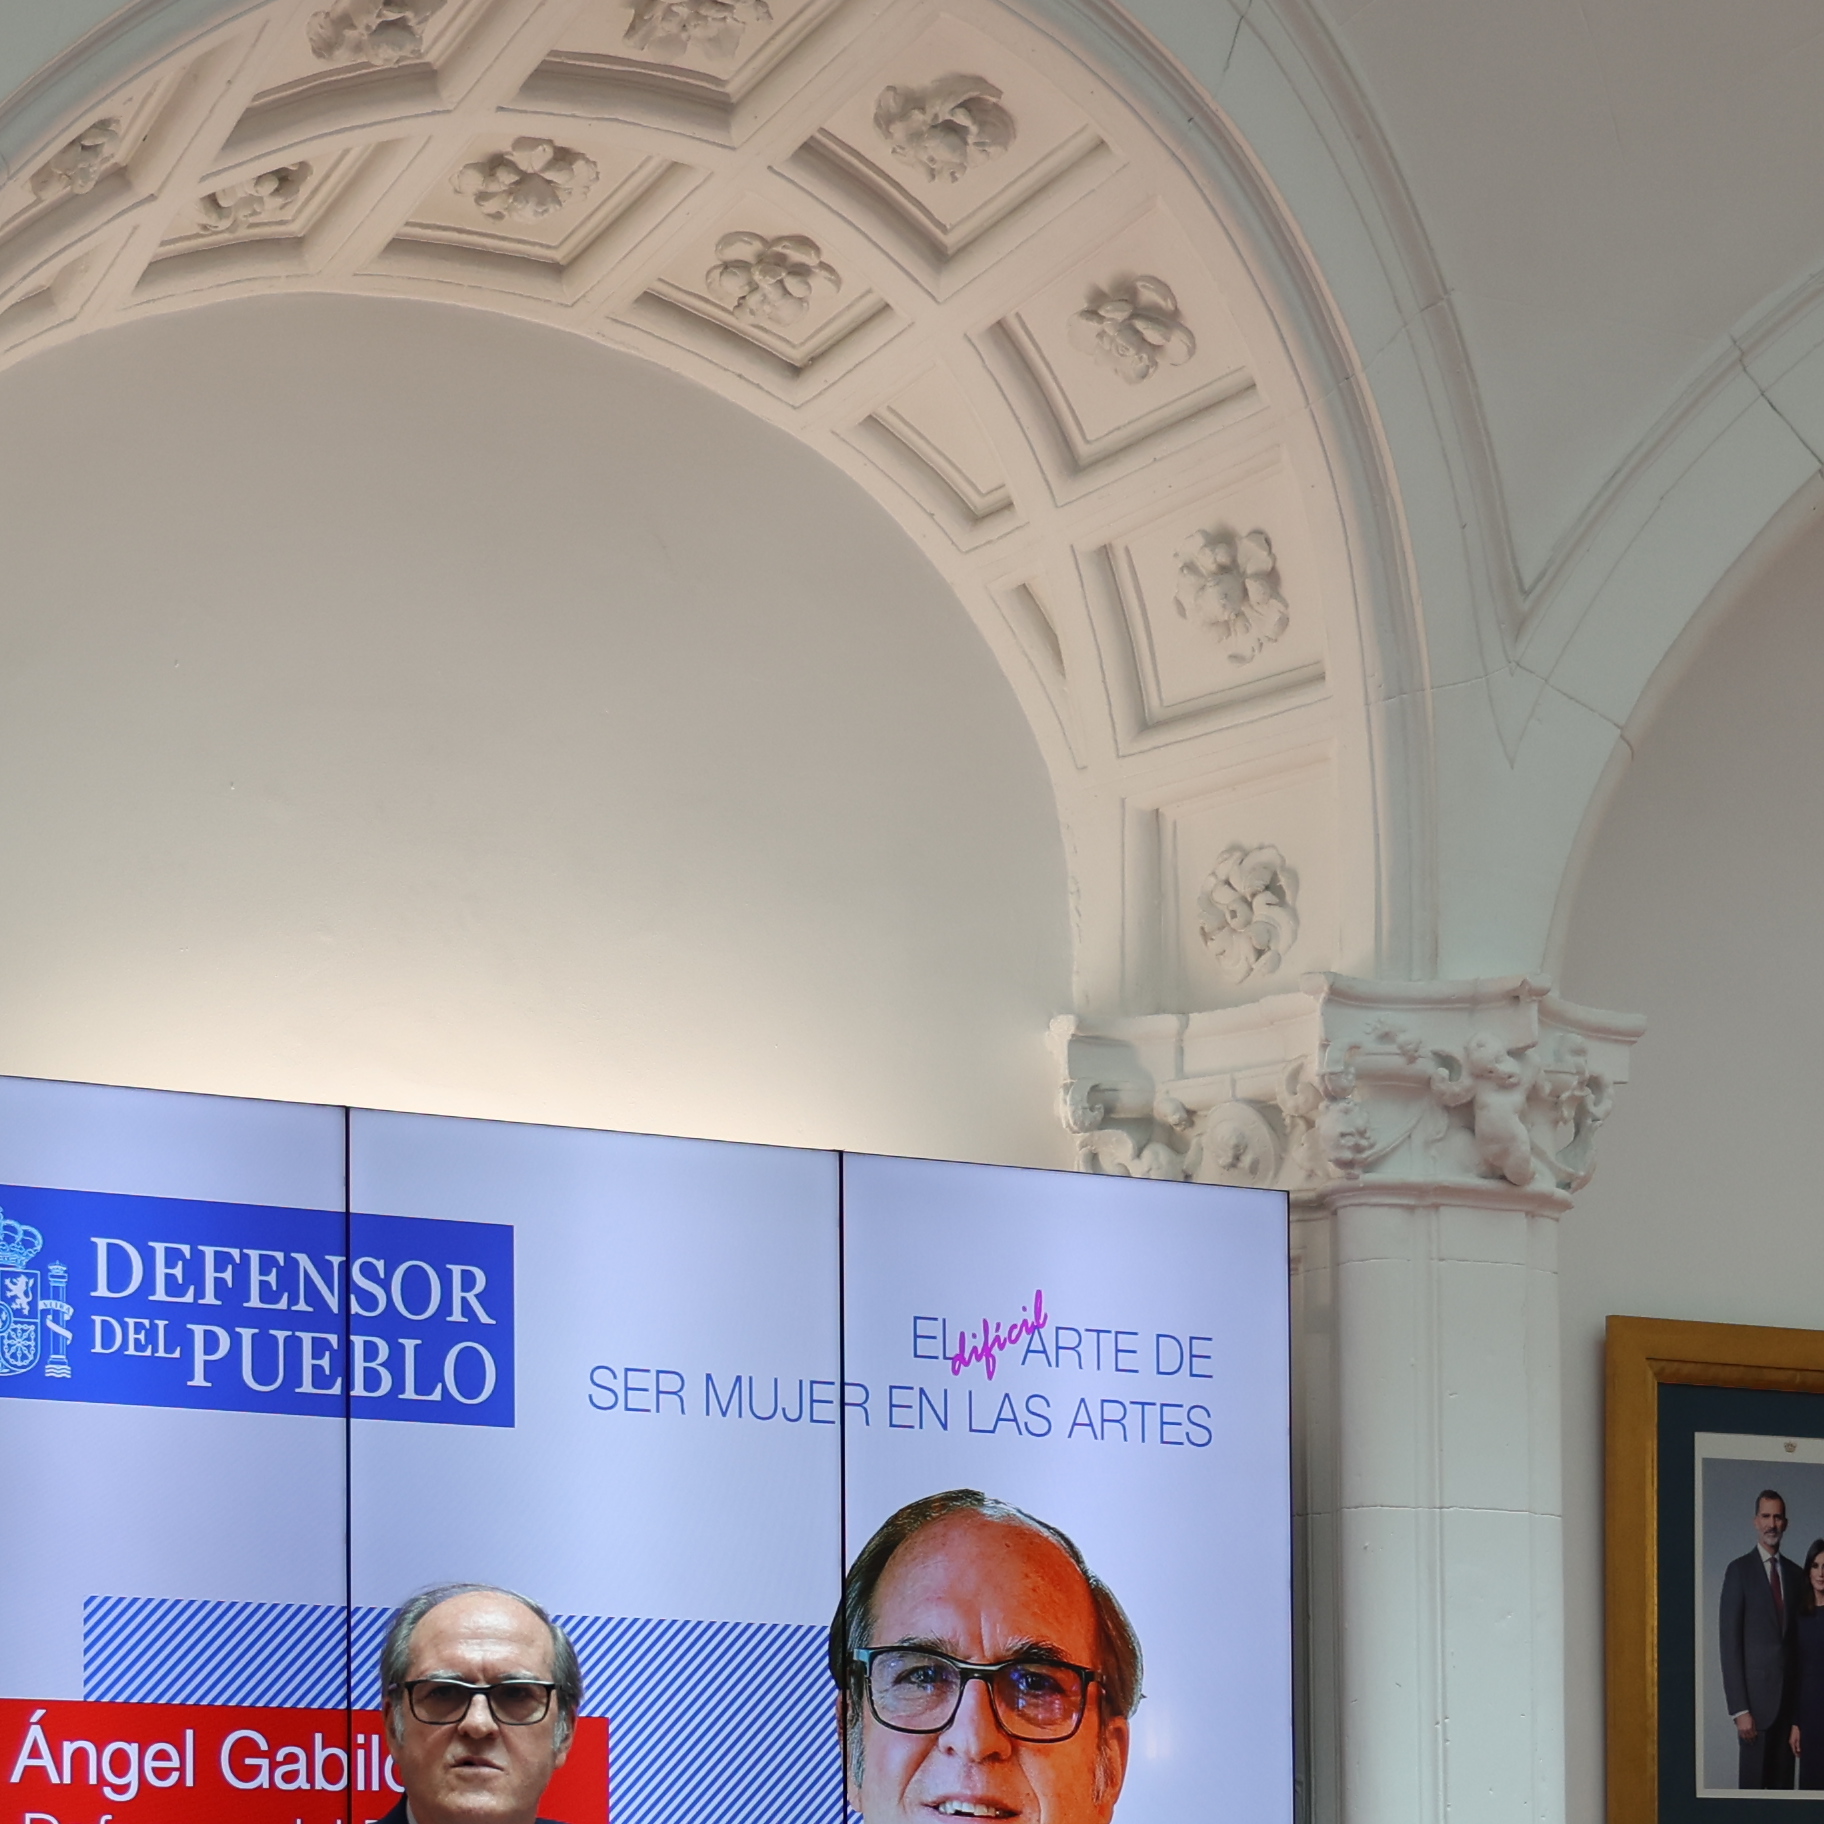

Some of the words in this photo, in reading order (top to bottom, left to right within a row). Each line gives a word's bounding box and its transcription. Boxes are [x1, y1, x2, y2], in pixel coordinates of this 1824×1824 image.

[90, 1236, 497, 1325] DEFENSOR
[90, 1315, 181, 1358] DEL
[186, 1324, 497, 1406] PUEBLO
[913, 1315, 956, 1361] EL
[950, 1289, 1049, 1381] difícil
[1021, 1324, 1140, 1374] ARTE
[1155, 1333, 1214, 1379] DE
[588, 1365, 686, 1415] SER
[705, 1372, 871, 1427] MUJER
[888, 1384, 949, 1432] EN
[968, 1389, 1052, 1438] LAS
[1067, 1397, 1214, 1448] ARTES
[9, 1708, 194, 1802] Ángel
